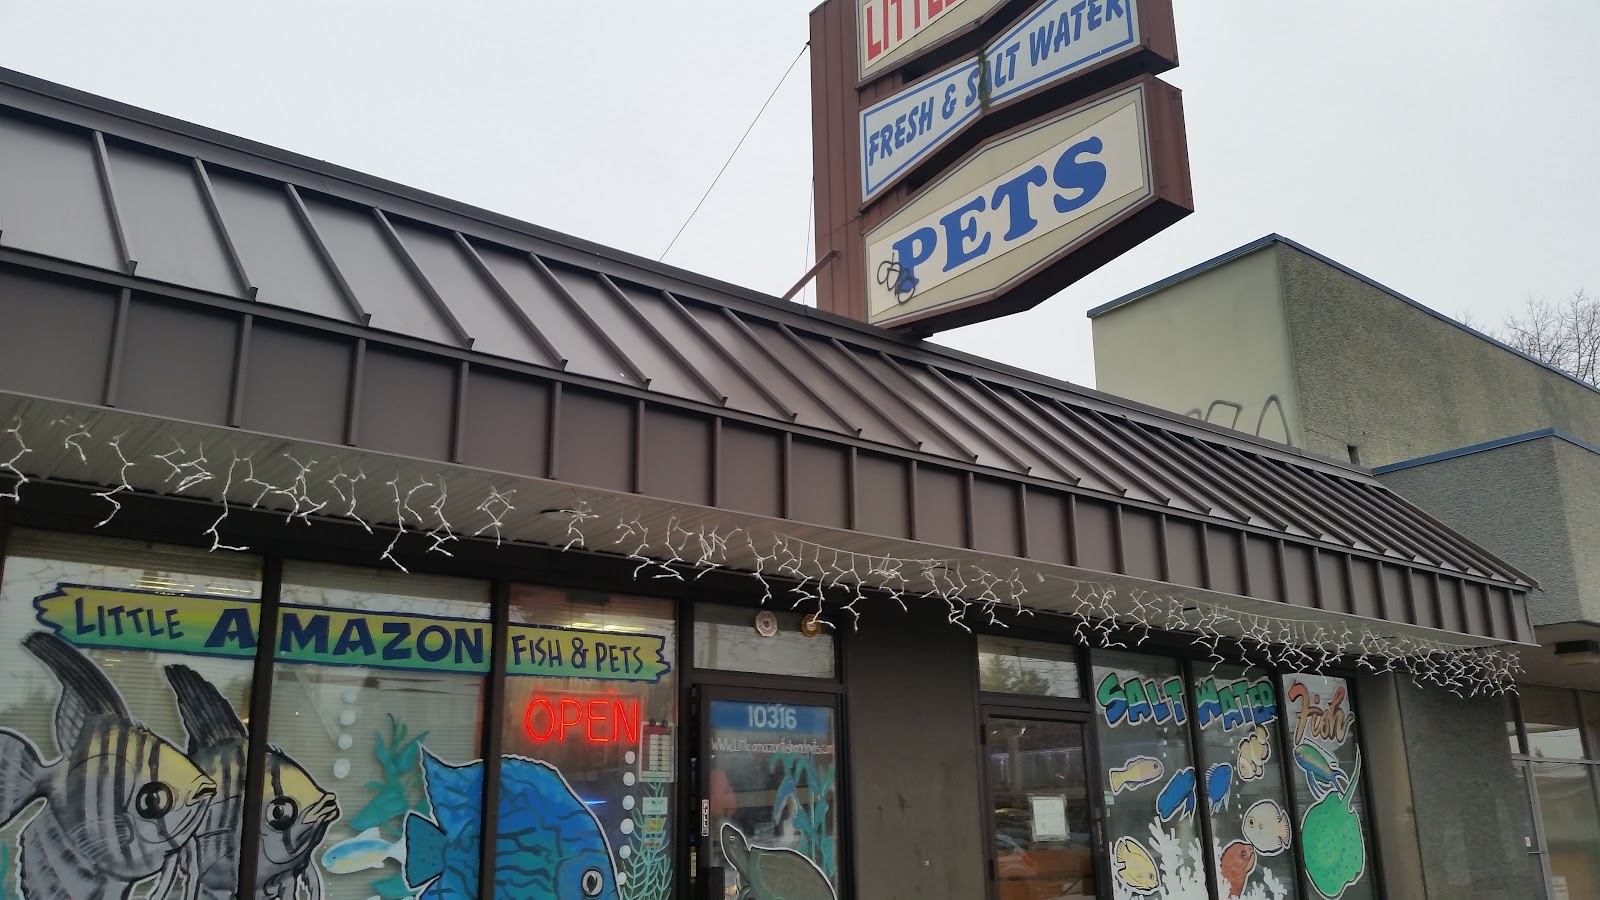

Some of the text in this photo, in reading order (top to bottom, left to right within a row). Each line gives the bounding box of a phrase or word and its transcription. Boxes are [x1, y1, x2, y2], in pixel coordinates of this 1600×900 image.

[868, 97, 934, 167] FRESH
[941, 83, 957, 120] &
[965, 41, 1020, 108] SALT
[892, 135, 1107, 294] PETS
[75, 598, 484, 664] LITTLE AMAZON
[512, 635, 644, 674] FISH & PETS
[525, 697, 639, 743] OPEN
[747, 704, 798, 730] 10316
[1096, 671, 1187, 728] SALT
[1288, 682, 1356, 744] Fish
